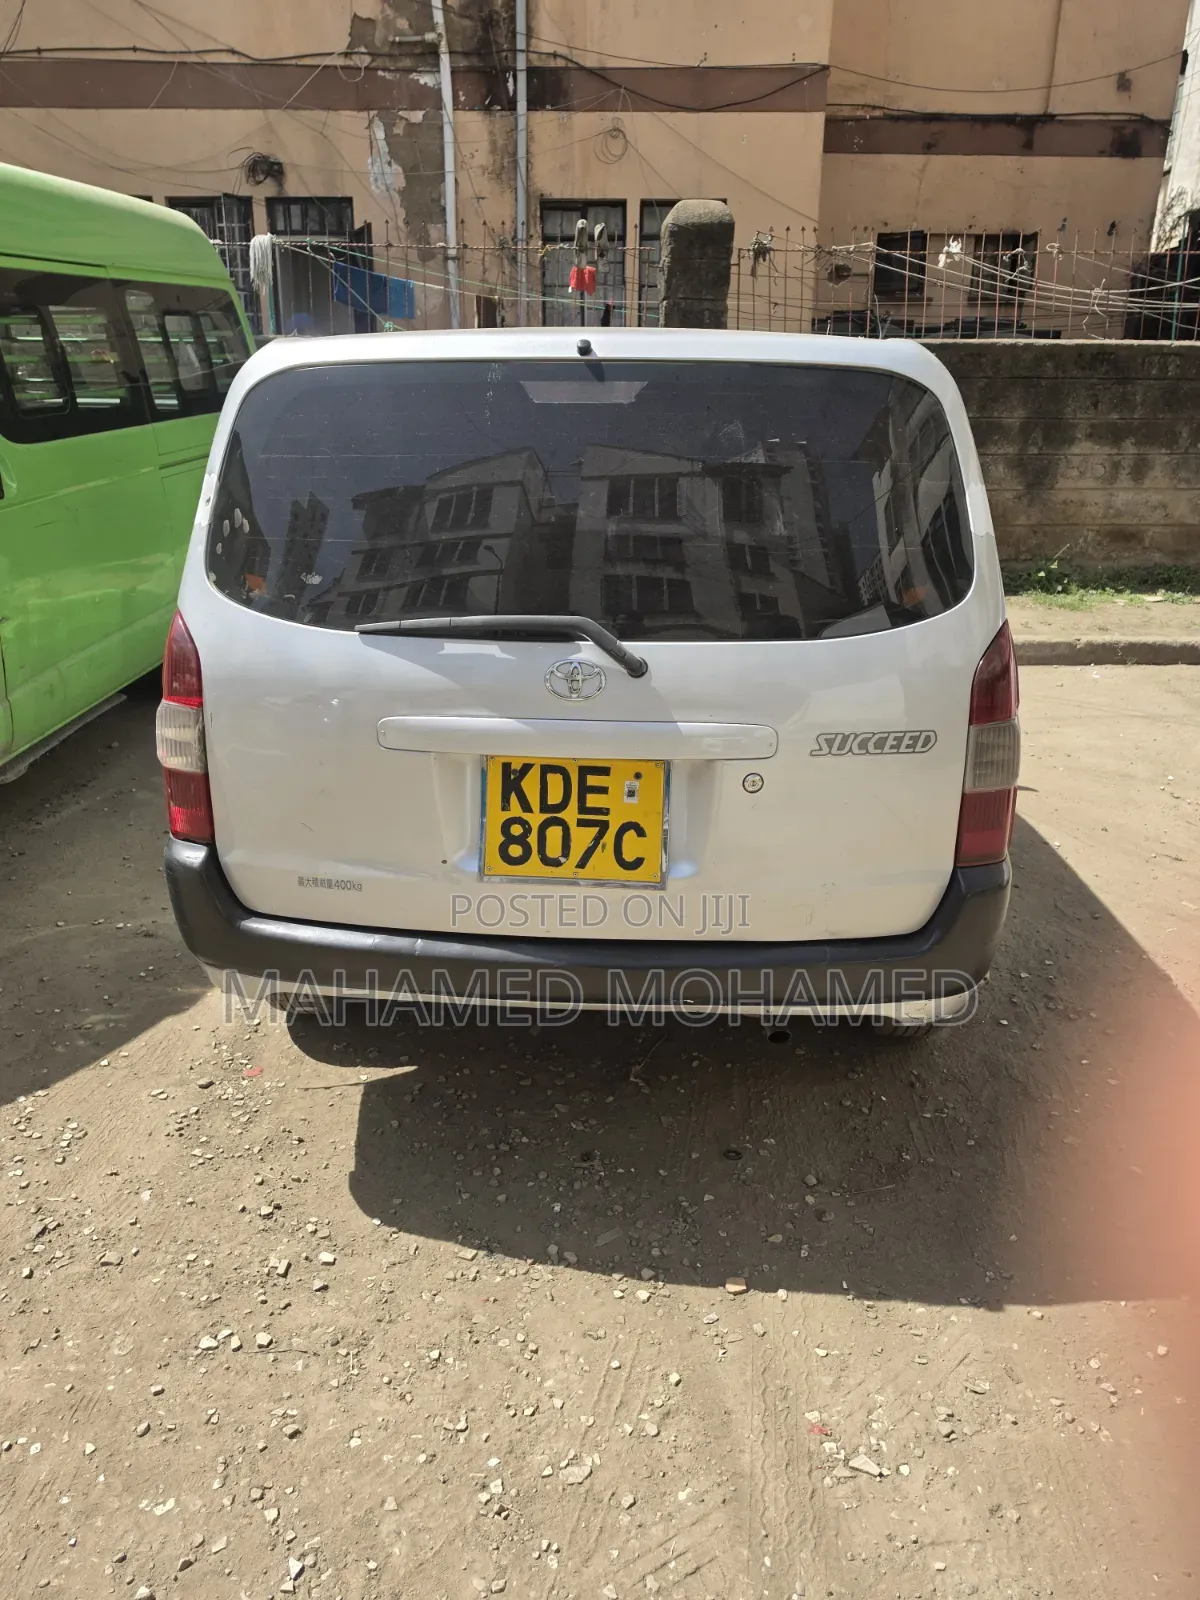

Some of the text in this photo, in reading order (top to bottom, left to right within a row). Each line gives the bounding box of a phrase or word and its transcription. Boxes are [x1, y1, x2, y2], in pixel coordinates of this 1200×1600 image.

[810, 730, 937, 756] SUCCEED
[500, 762, 611, 816] KDE
[498, 816, 647, 871] 807C
